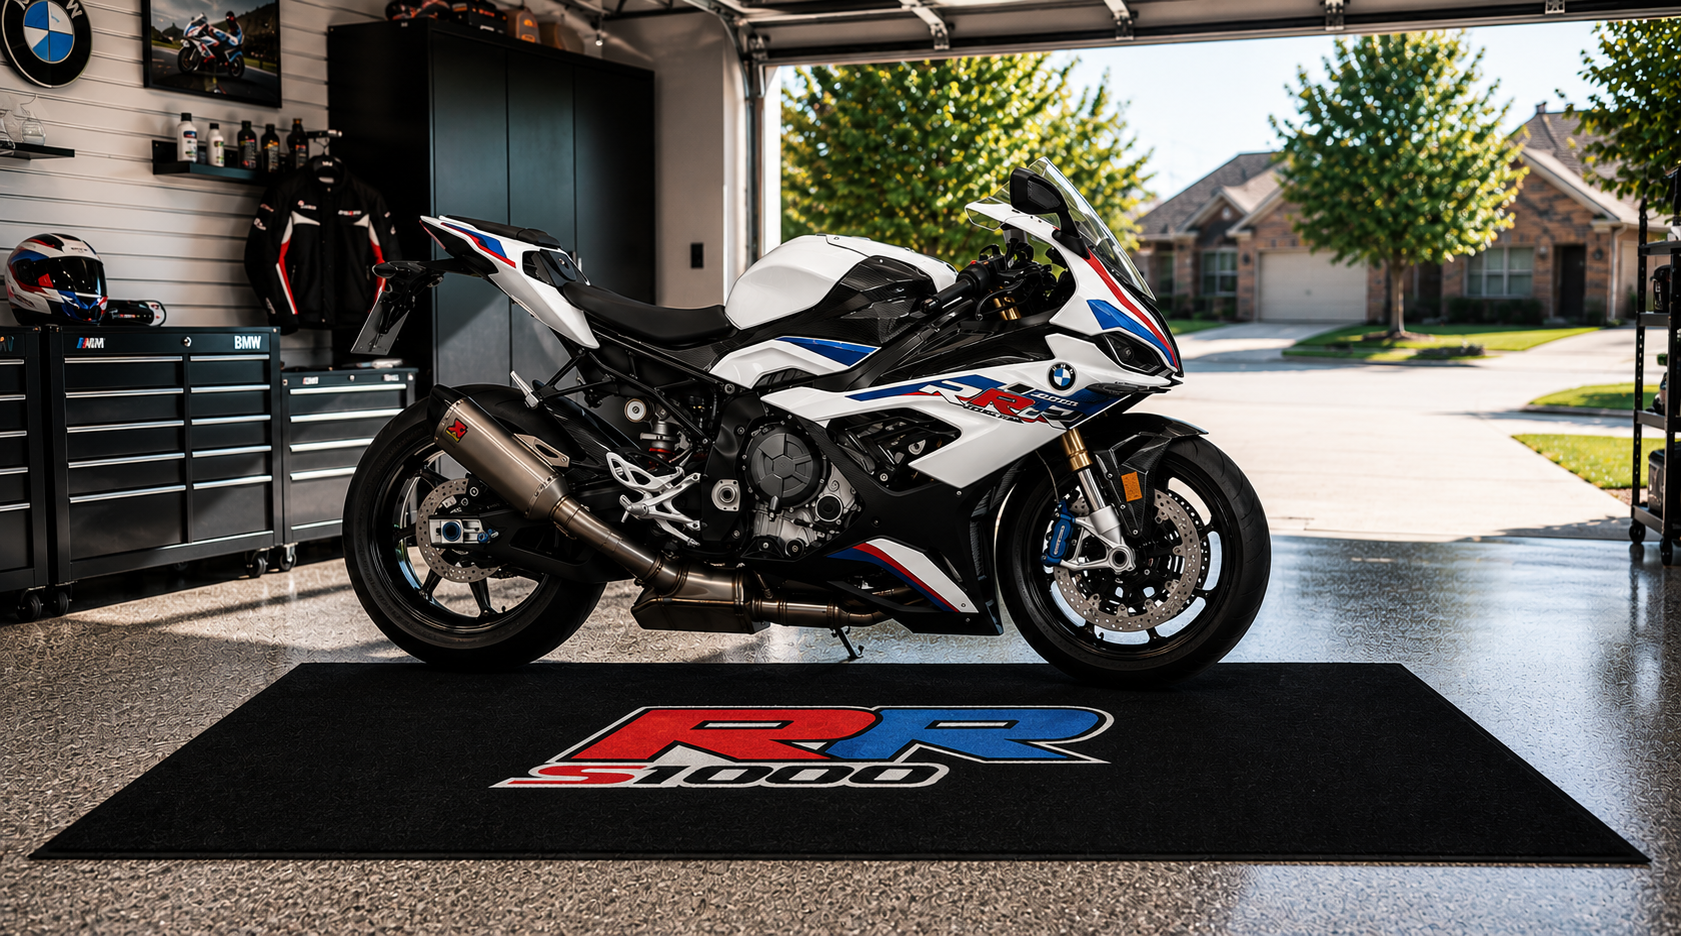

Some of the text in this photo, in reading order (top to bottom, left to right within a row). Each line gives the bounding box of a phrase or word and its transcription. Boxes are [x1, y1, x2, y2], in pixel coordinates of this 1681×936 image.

[234, 335, 261, 349] BMW
[548, 705, 1109, 763] RR
[494, 763, 947, 787] S1000
